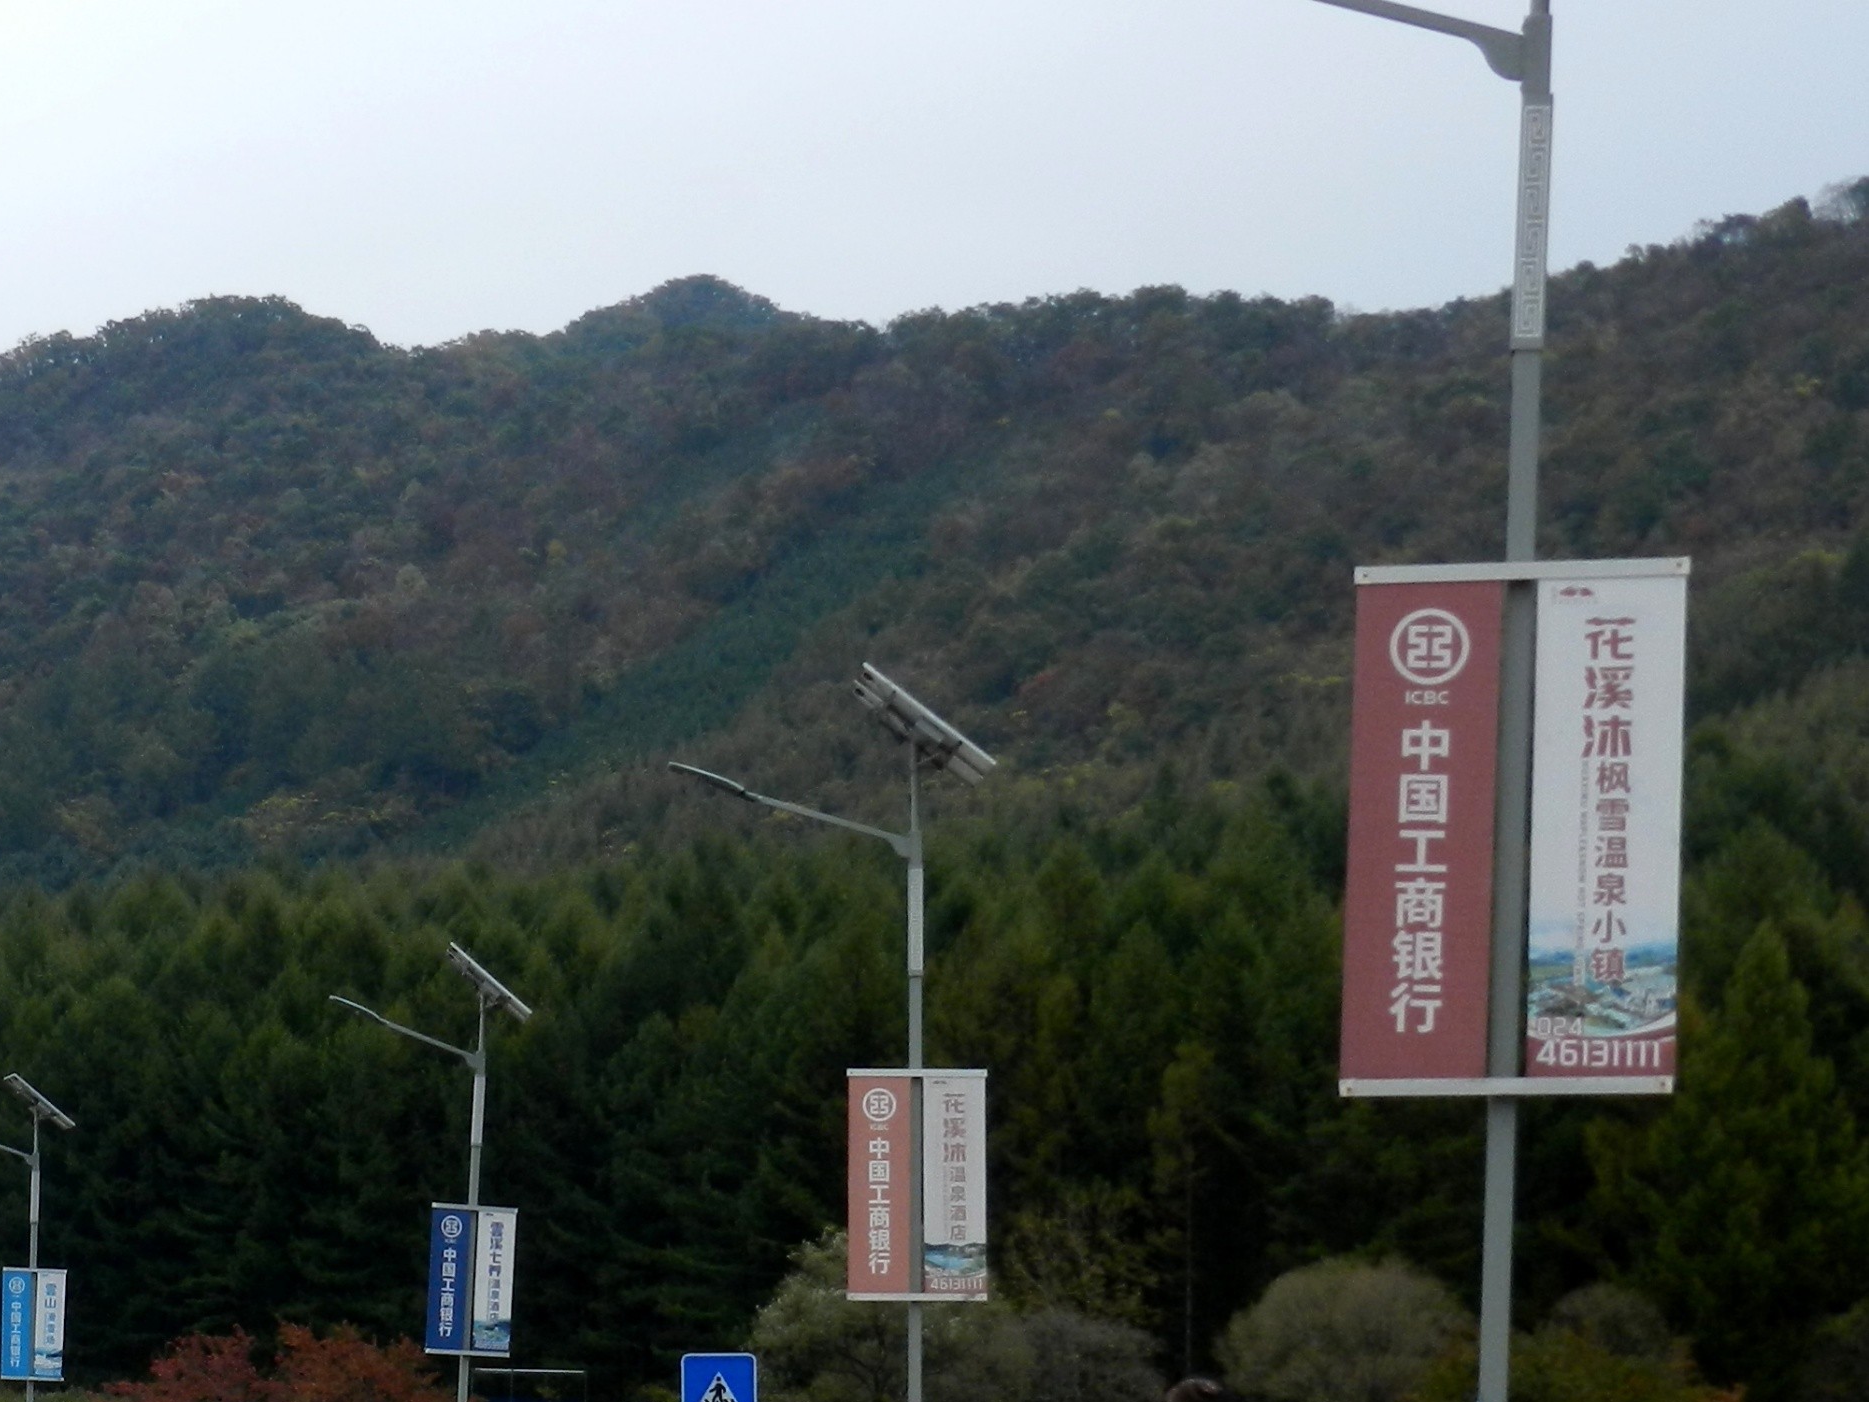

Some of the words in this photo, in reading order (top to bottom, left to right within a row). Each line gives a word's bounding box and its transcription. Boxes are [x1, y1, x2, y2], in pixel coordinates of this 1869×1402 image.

[1405, 690, 1449, 704] ICBC
[1583, 616, 1637, 984] 花溪沐枫雪温泉小镇
[1389, 718, 1451, 1034] 中国工商银行
[1536, 1039, 1660, 1067] 46131111
[1537, 1016, 1582, 1036] 024
[868, 1137, 891, 1274] 中国工商银行
[438, 1247, 457, 1337] 中国工商银行
